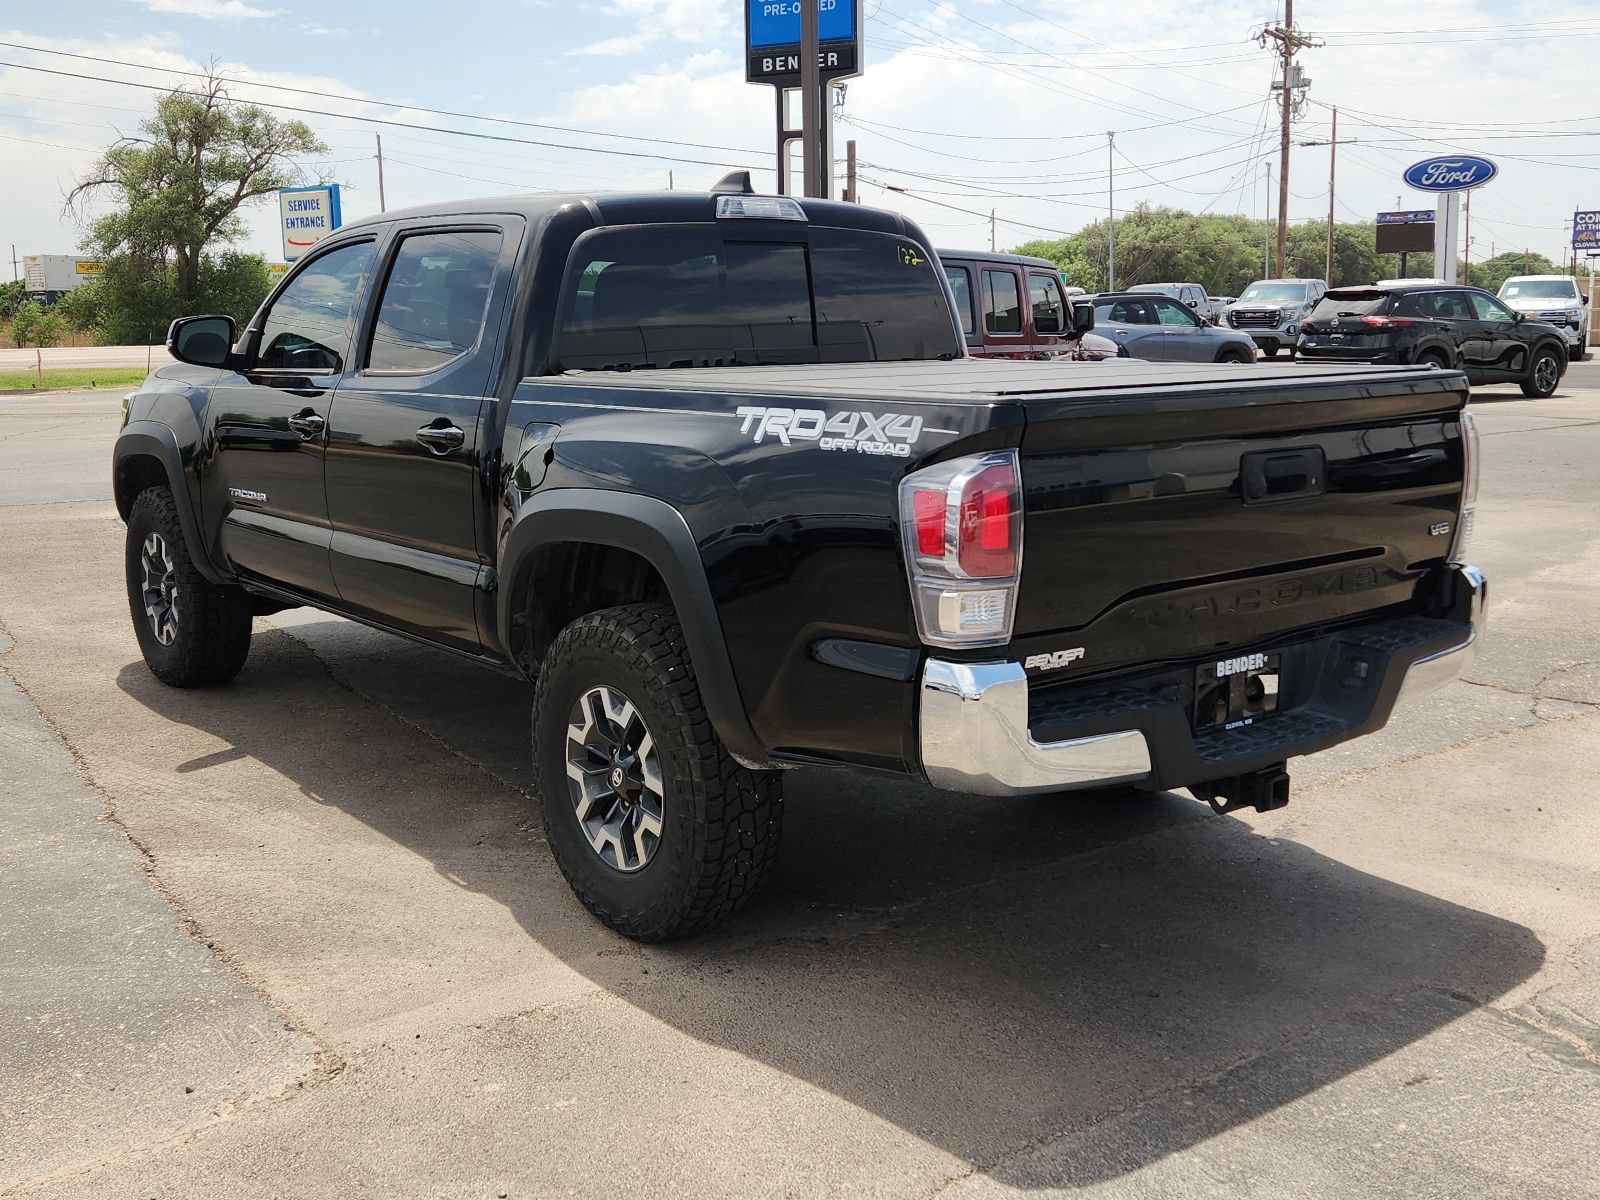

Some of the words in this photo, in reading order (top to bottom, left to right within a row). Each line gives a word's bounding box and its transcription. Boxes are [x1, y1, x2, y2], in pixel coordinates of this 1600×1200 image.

[764, 0, 836, 16] PRE-OED
[762, 52, 838, 71] BENER
[1422, 162, 1478, 184] Ford
[288, 199, 320, 211] SERVICE
[286, 216, 325, 229] ENTRANCE
[736, 406, 827, 447] TRD
[819, 437, 857, 452] OFF
[856, 439, 911, 458] ROAD
[1025, 647, 1085, 668] BENDER
[1216, 653, 1264, 678] BENDER
